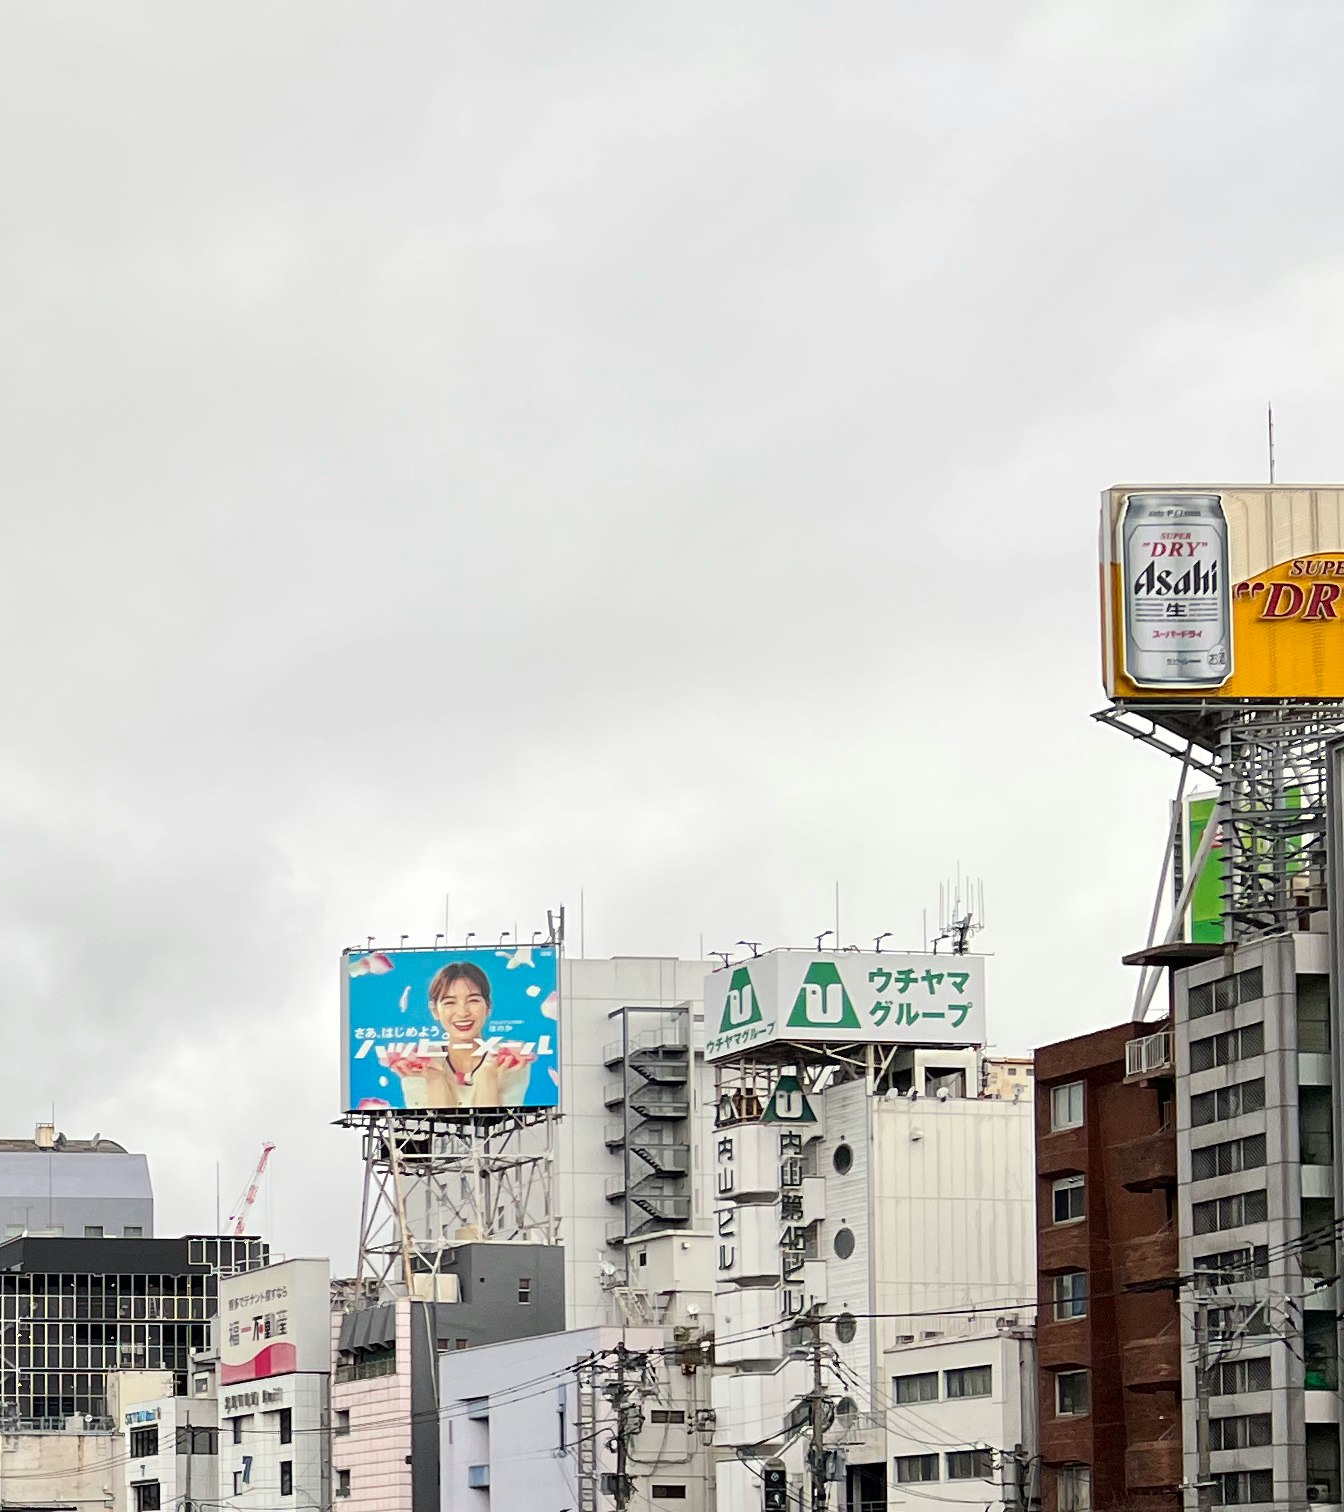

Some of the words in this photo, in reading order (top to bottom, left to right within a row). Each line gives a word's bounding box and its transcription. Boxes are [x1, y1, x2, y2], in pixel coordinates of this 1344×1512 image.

[1160, 532, 1191, 540] SUPER
[1134, 559, 1218, 596] Asahi
[1165, 602, 1188, 618] 生
[1152, 630, 1203, 639] スーパードライ
[868, 967, 970, 995] ウチヤマ
[868, 1000, 973, 1029] グループ
[353, 1035, 554, 1059] ハッピーメール
[706, 1021, 775, 1054] ウチヤマグループ
[718, 1136, 735, 1271] 内山ビル
[779, 1131, 806, 1316] 内山第45ビル
[228, 1310, 288, 1347] 福一不動産
